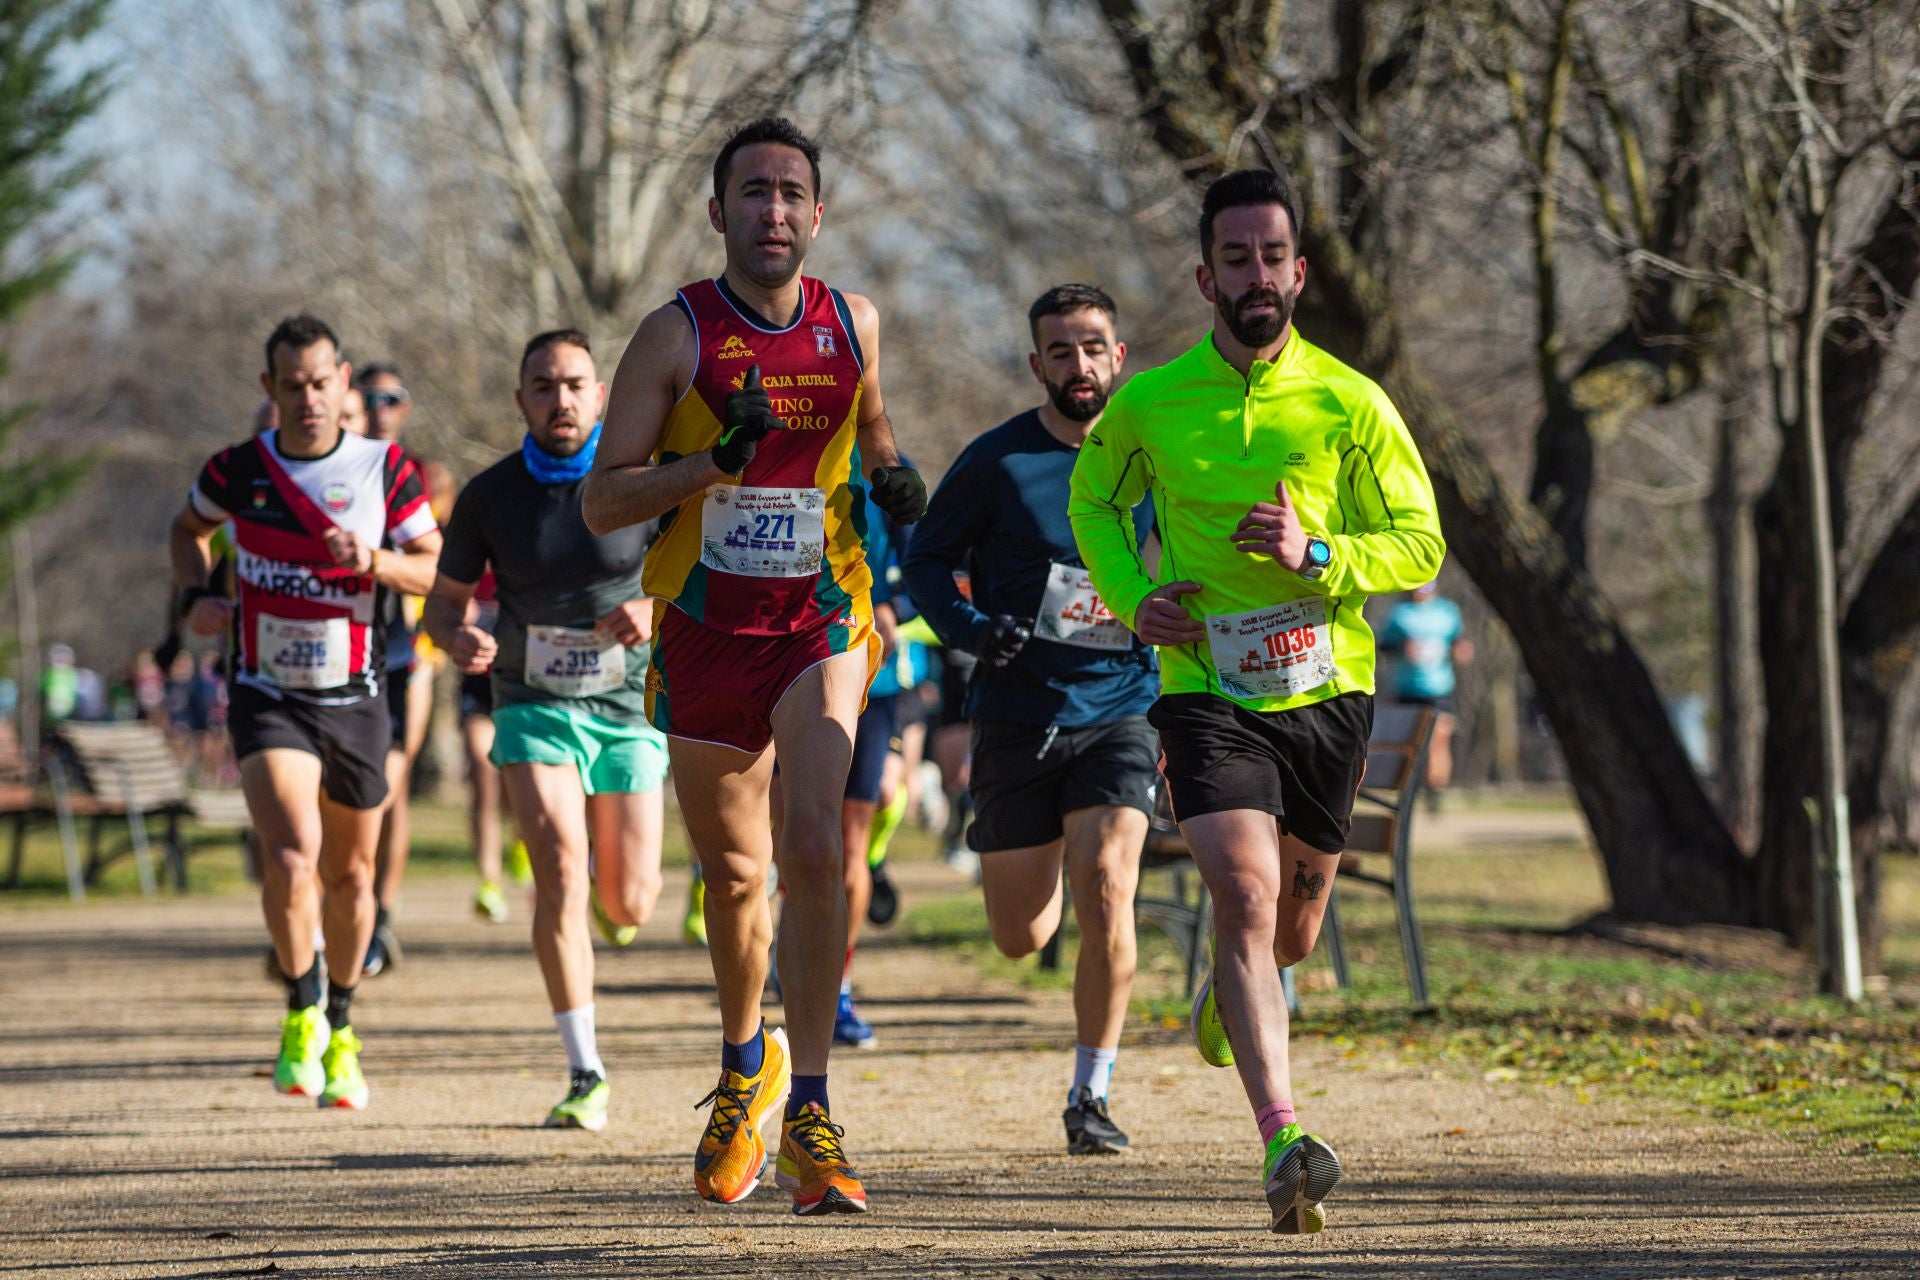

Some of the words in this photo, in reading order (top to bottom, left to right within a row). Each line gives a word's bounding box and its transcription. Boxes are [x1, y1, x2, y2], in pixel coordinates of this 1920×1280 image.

[718, 349, 756, 360] austral
[762, 375, 794, 388] CAJA
[797, 374, 837, 387] RURAL
[754, 513, 795, 539] 271
[255, 574, 359, 598] ARROYO
[1263, 623, 1316, 659] 1036
[566, 650, 599, 668] 313
